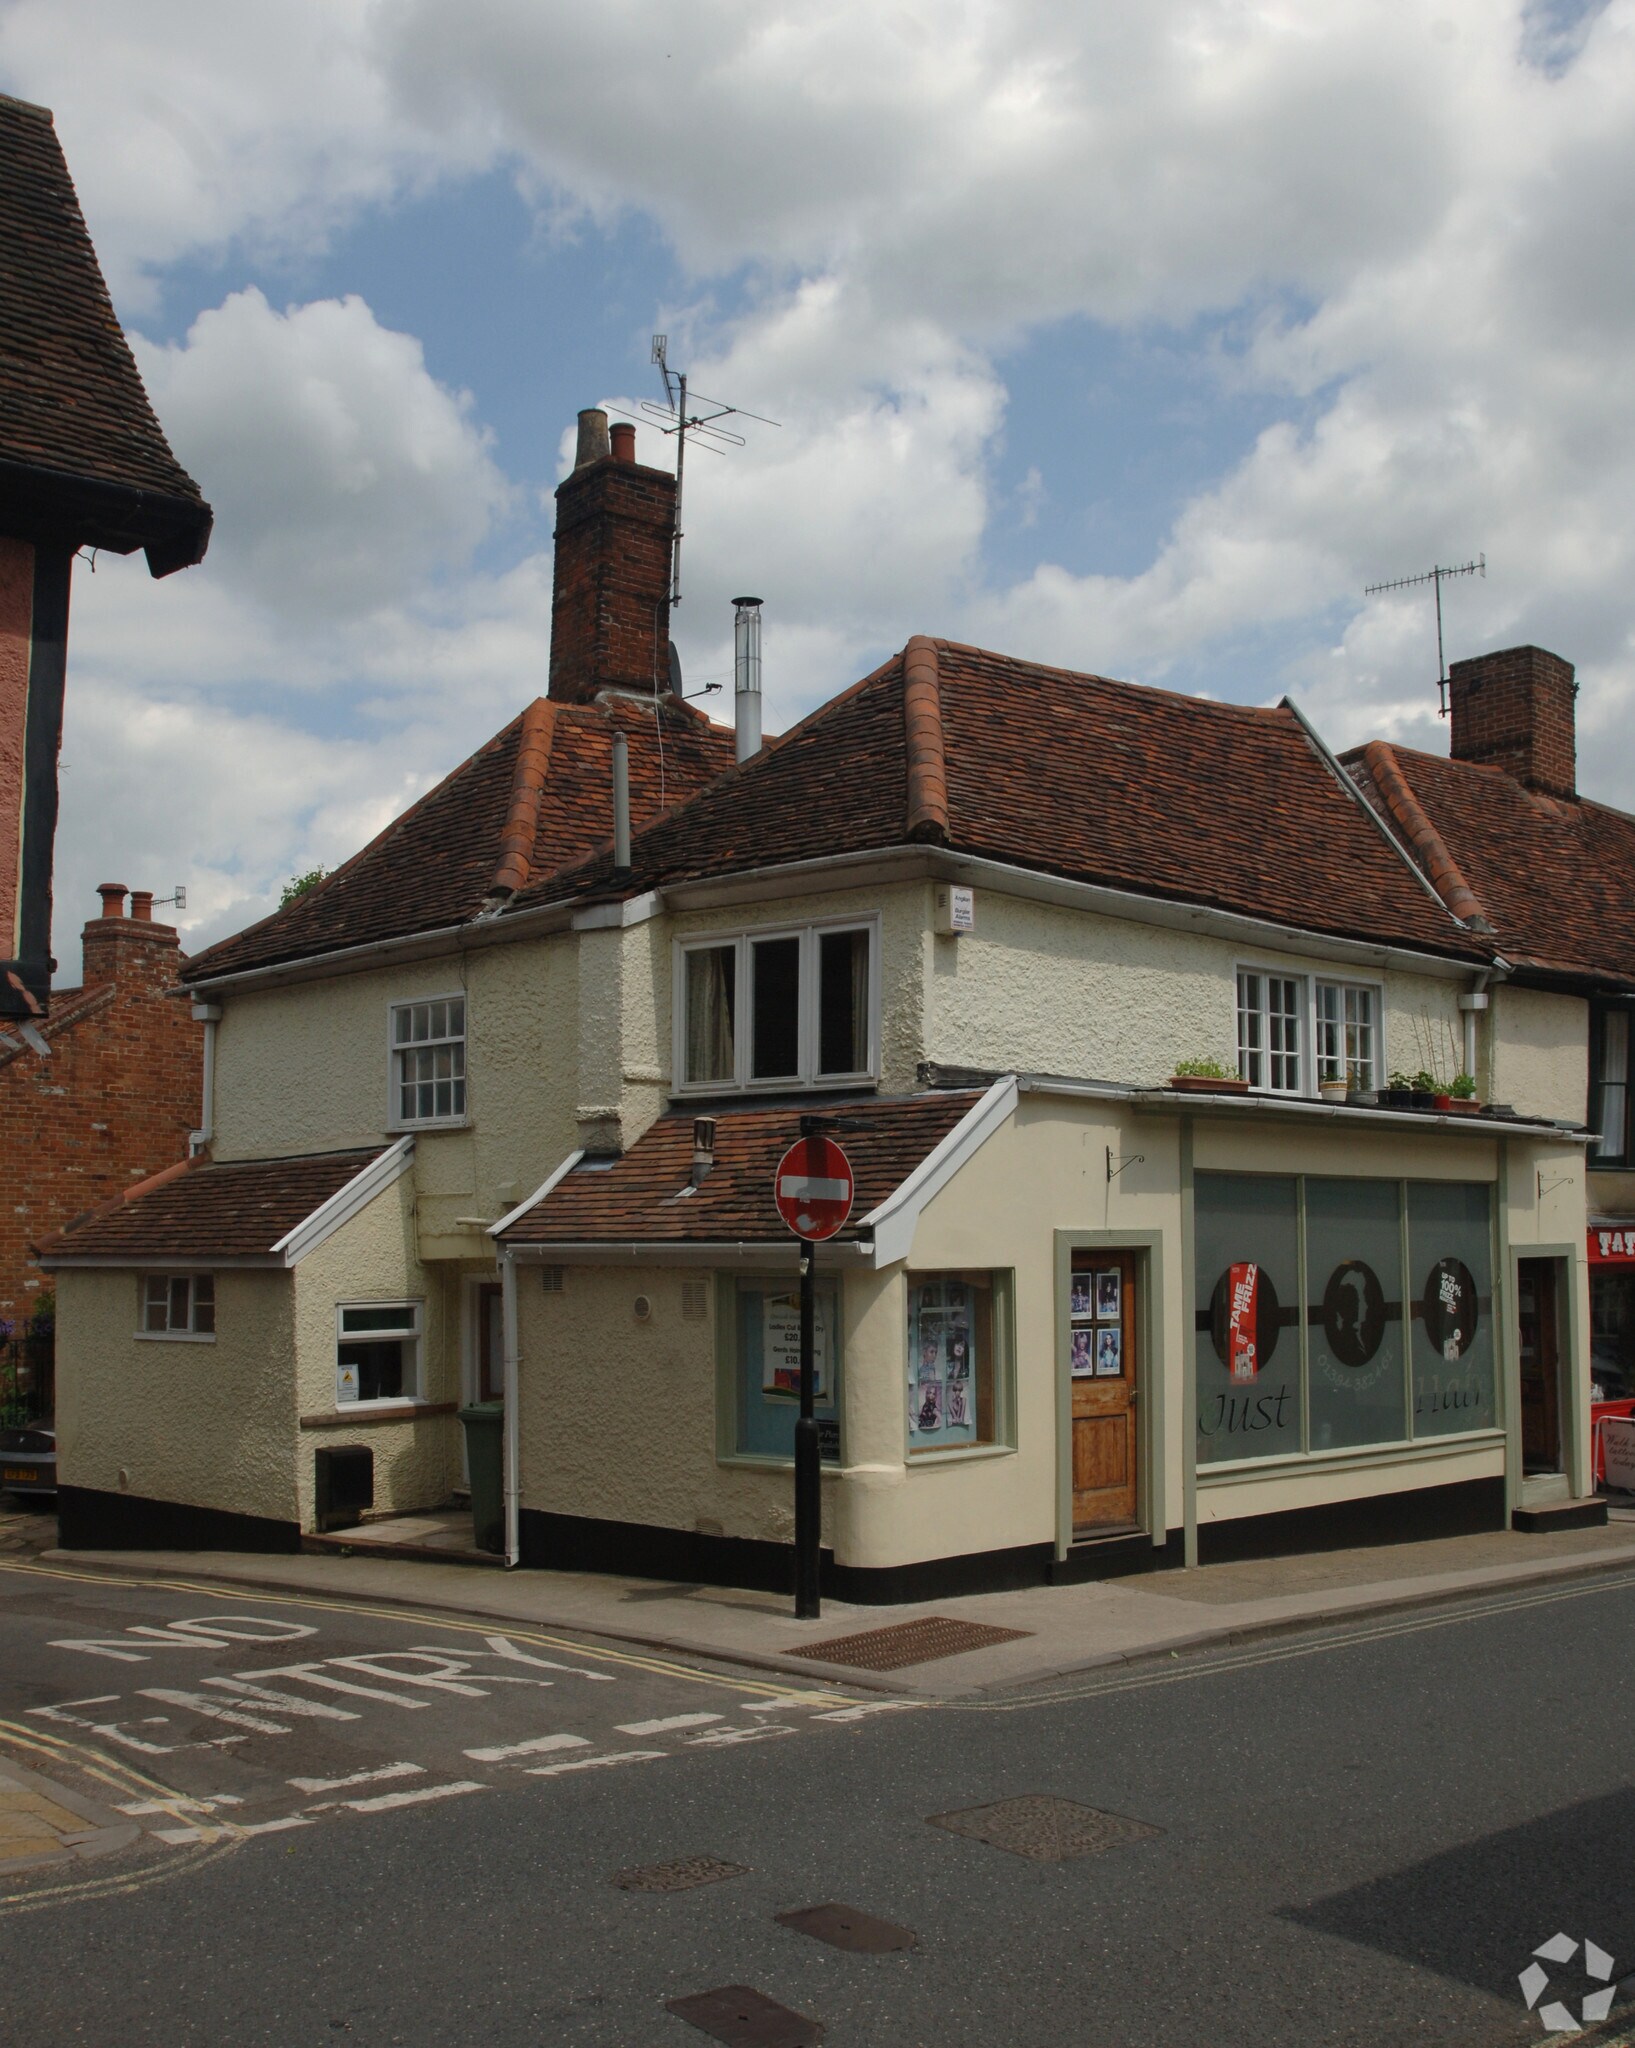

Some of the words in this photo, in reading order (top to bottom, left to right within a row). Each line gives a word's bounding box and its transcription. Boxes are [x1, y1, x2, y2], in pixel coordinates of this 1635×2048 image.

[954, 907, 970, 915] Burglar
[1241, 1263, 1258, 1313] FRIZZ
[1439, 1289, 1454, 1301] FRIZZ
[1440, 1279, 1462, 1297] 100%
[1448, 1275, 1456, 1284] TO
[1230, 1281, 1245, 1329] TAME
[769, 1323, 785, 1331] Ladies
[787, 1323, 796, 1331] Cut
[815, 1325, 824, 1334] Dry
[1198, 1383, 1292, 1436] Just
[47, 1613, 319, 1662] NO
[25, 1636, 616, 1754] ENTRY
